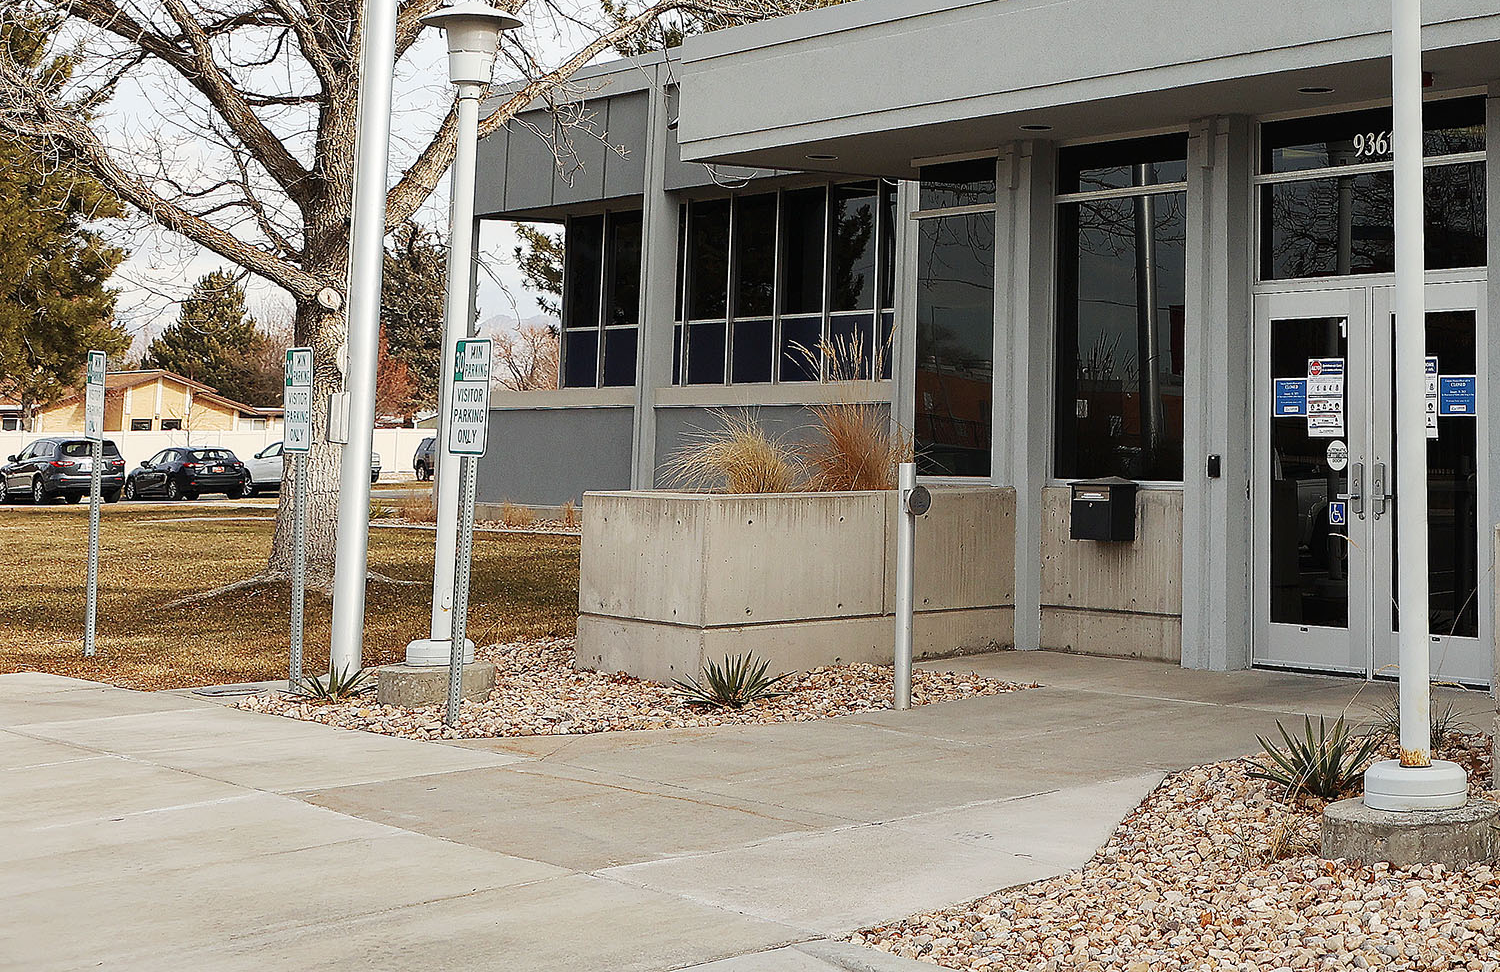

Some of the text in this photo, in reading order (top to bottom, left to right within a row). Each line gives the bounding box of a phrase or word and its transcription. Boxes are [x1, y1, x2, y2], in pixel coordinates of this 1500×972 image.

[1353, 130, 1394, 157] 9361
[1338, 319, 1347, 338] 1
[455, 345, 483, 373] 30 MIN
[464, 363, 488, 378] PARKING
[288, 392, 308, 406] VISITOR
[457, 388, 483, 403] VISITOR
[286, 410, 308, 424] PARKING
[453, 408, 484, 423] PARKING
[457, 429, 477, 444] ONLY
